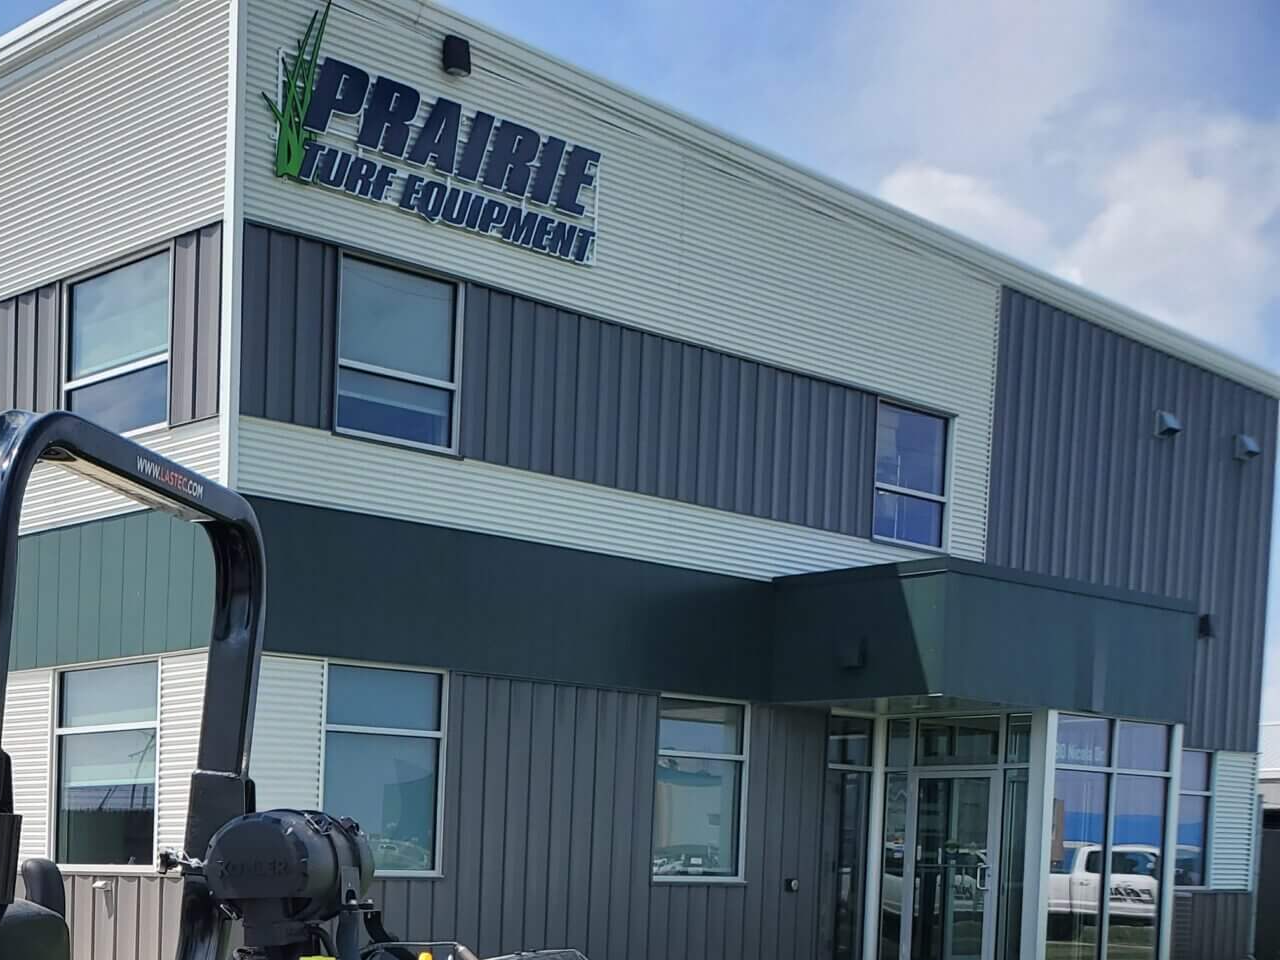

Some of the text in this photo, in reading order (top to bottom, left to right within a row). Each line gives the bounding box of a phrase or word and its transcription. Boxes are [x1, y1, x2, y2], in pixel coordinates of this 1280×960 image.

[303, 57, 601, 217] PRAIRIE
[299, 141, 596, 265] TURF EQUIPMENT
[136, 455, 204, 500] WWW.LASTEC.COM
